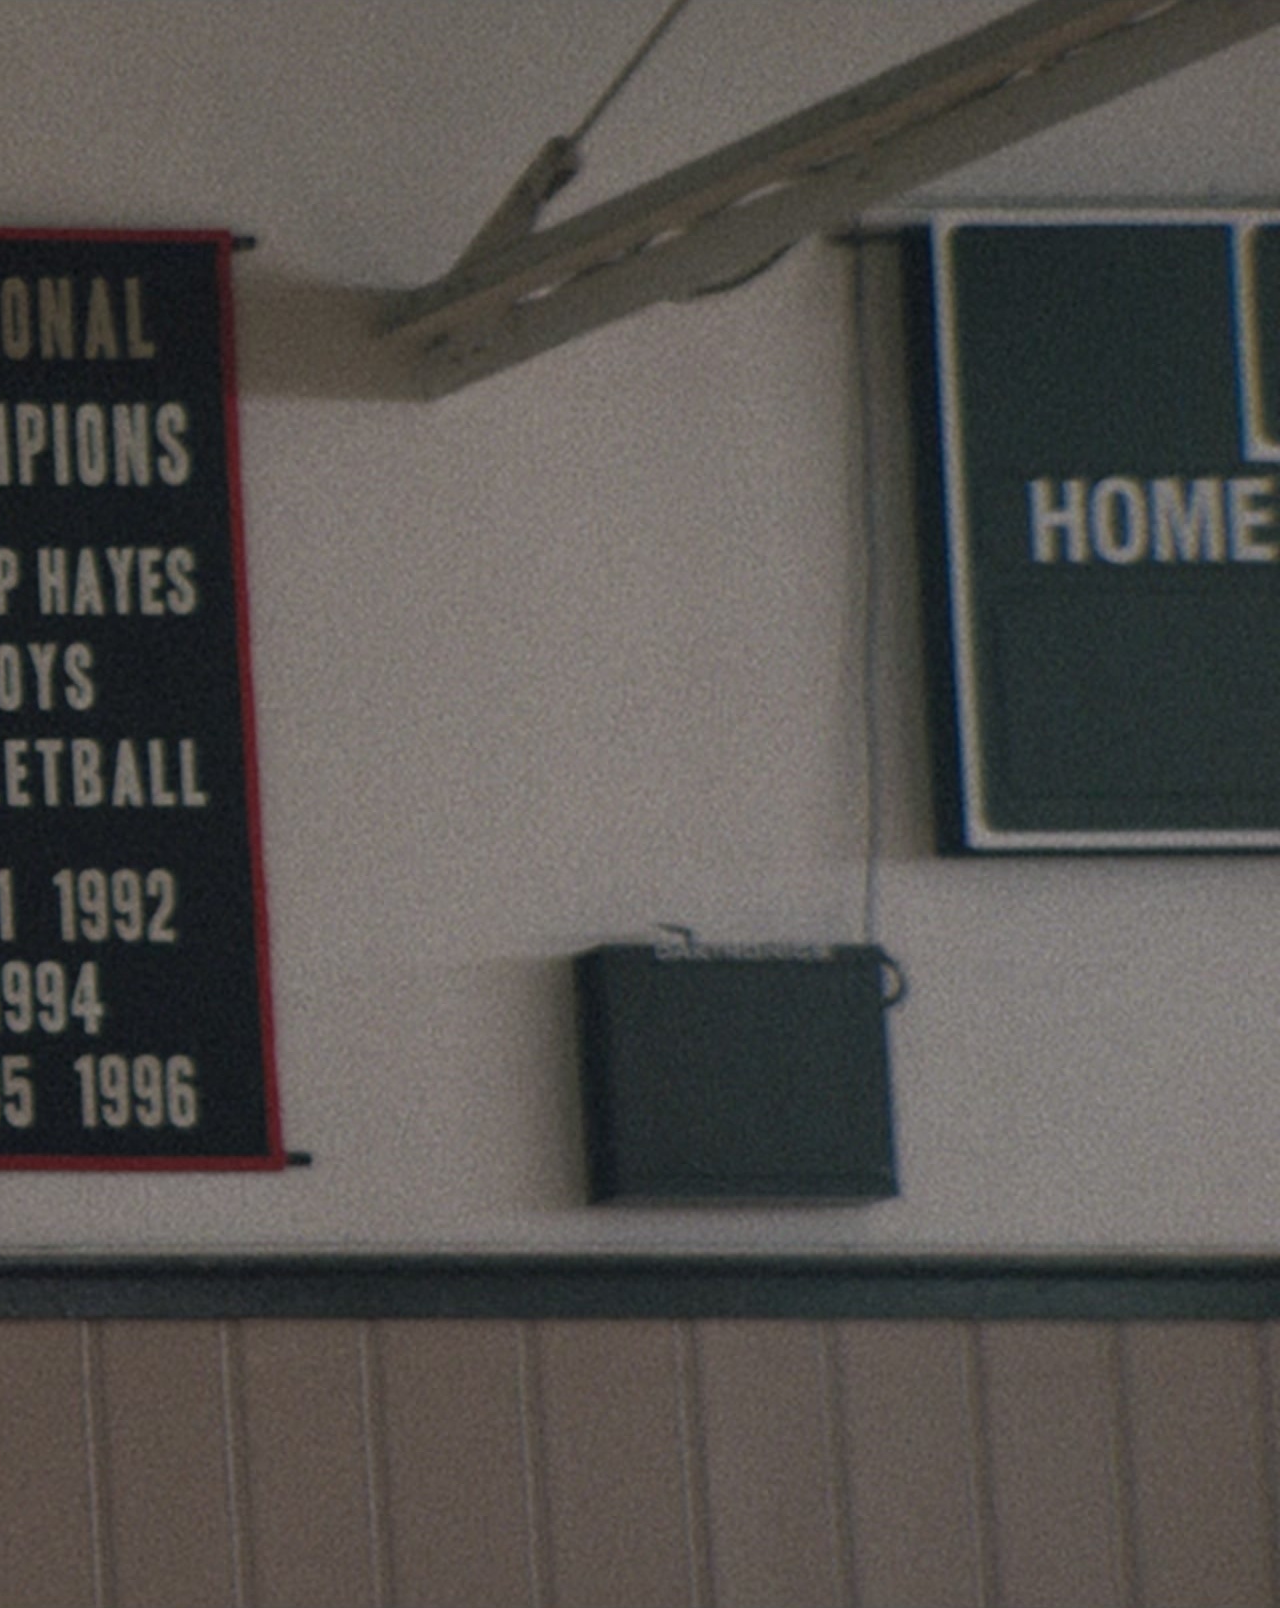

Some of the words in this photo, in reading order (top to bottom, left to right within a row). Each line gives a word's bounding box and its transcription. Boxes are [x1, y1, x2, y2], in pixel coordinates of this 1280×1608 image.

[1027, 473, 1278, 566] HOME
[37, 546, 197, 616] HAYES
[52, 868, 177, 943] 1992
[73, 1054, 198, 1129] 1996
